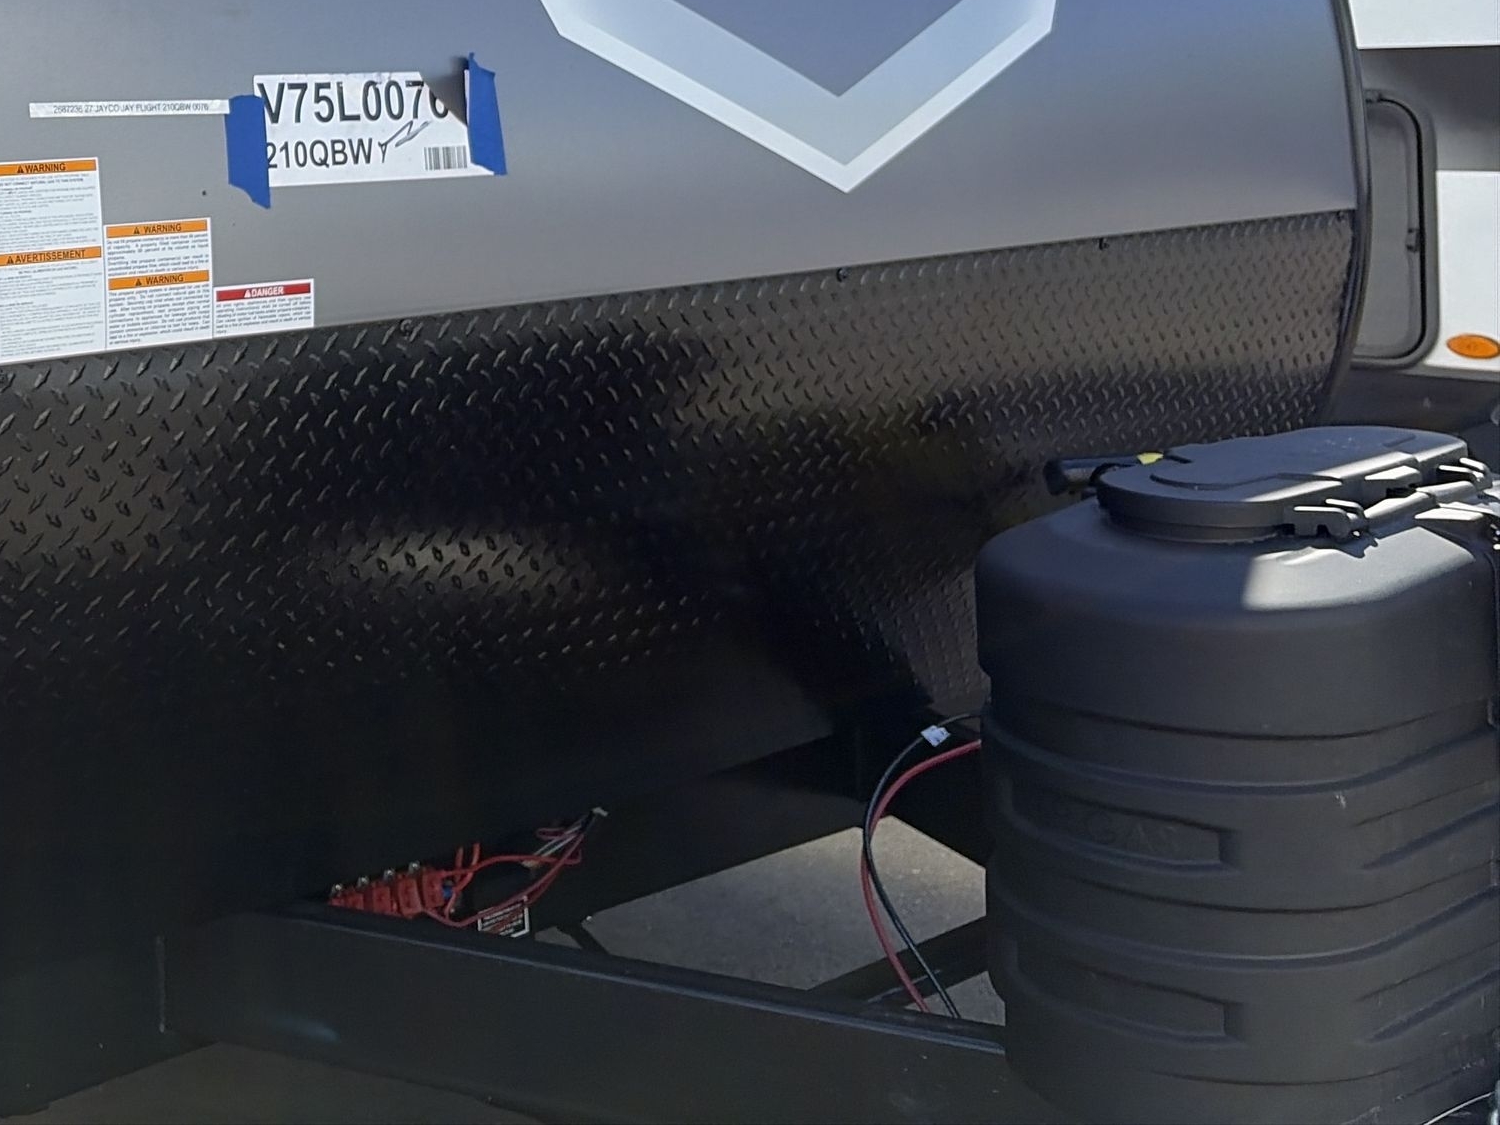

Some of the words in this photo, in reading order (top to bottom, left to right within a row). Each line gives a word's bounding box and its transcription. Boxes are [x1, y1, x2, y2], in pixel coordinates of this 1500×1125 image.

[95, 103, 120, 113] JAYCO
[121, 103, 134, 112] JAY
[135, 102, 160, 112] FLIGHT
[266, 138, 373, 169] 210QBW
[25, 162, 66, 174] WARNING
[143, 223, 182, 234] WARNING
[15, 249, 86, 264] AVERTISSEMENT
[145, 274, 184, 285] WARNING
[251, 286, 285, 298] DANGER
